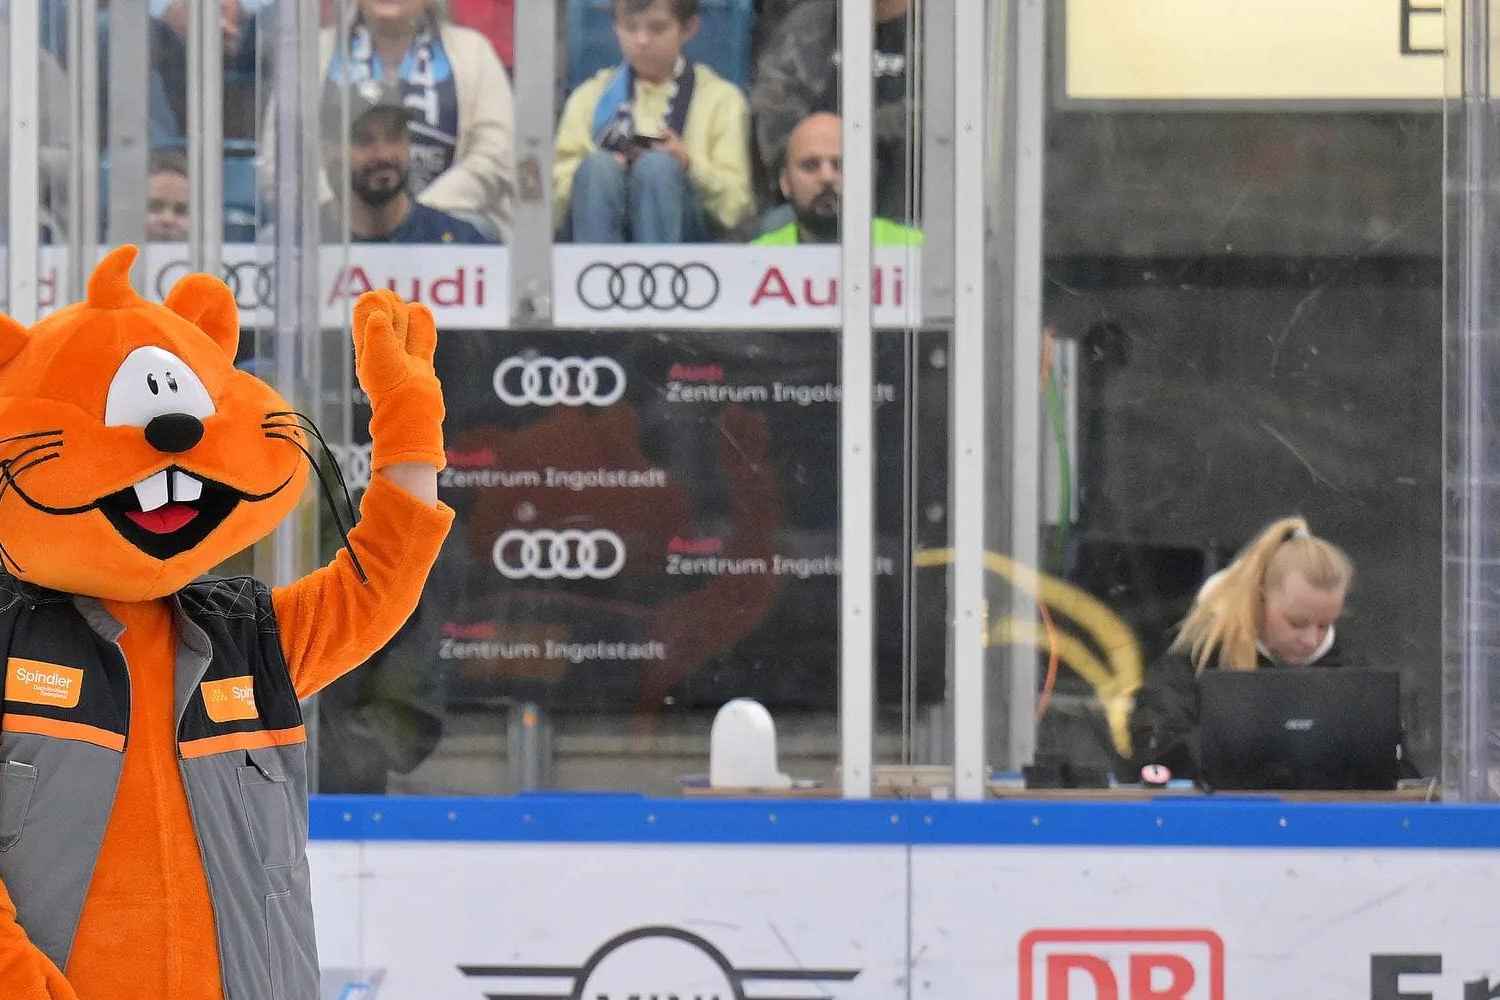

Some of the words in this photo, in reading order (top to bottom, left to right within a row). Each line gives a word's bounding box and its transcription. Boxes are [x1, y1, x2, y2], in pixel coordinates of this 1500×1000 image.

[328, 266, 487, 308] Audi
[666, 382, 769, 403] Zentrum
[439, 467, 541, 488] Zentrum
[544, 466, 668, 492] Ingolstadt
[665, 554, 768, 575] Zentrum
[438, 638, 541, 660] Zentrum
[544, 638, 667, 664] Ingolstadt
[16, 667, 73, 689] Spindler
